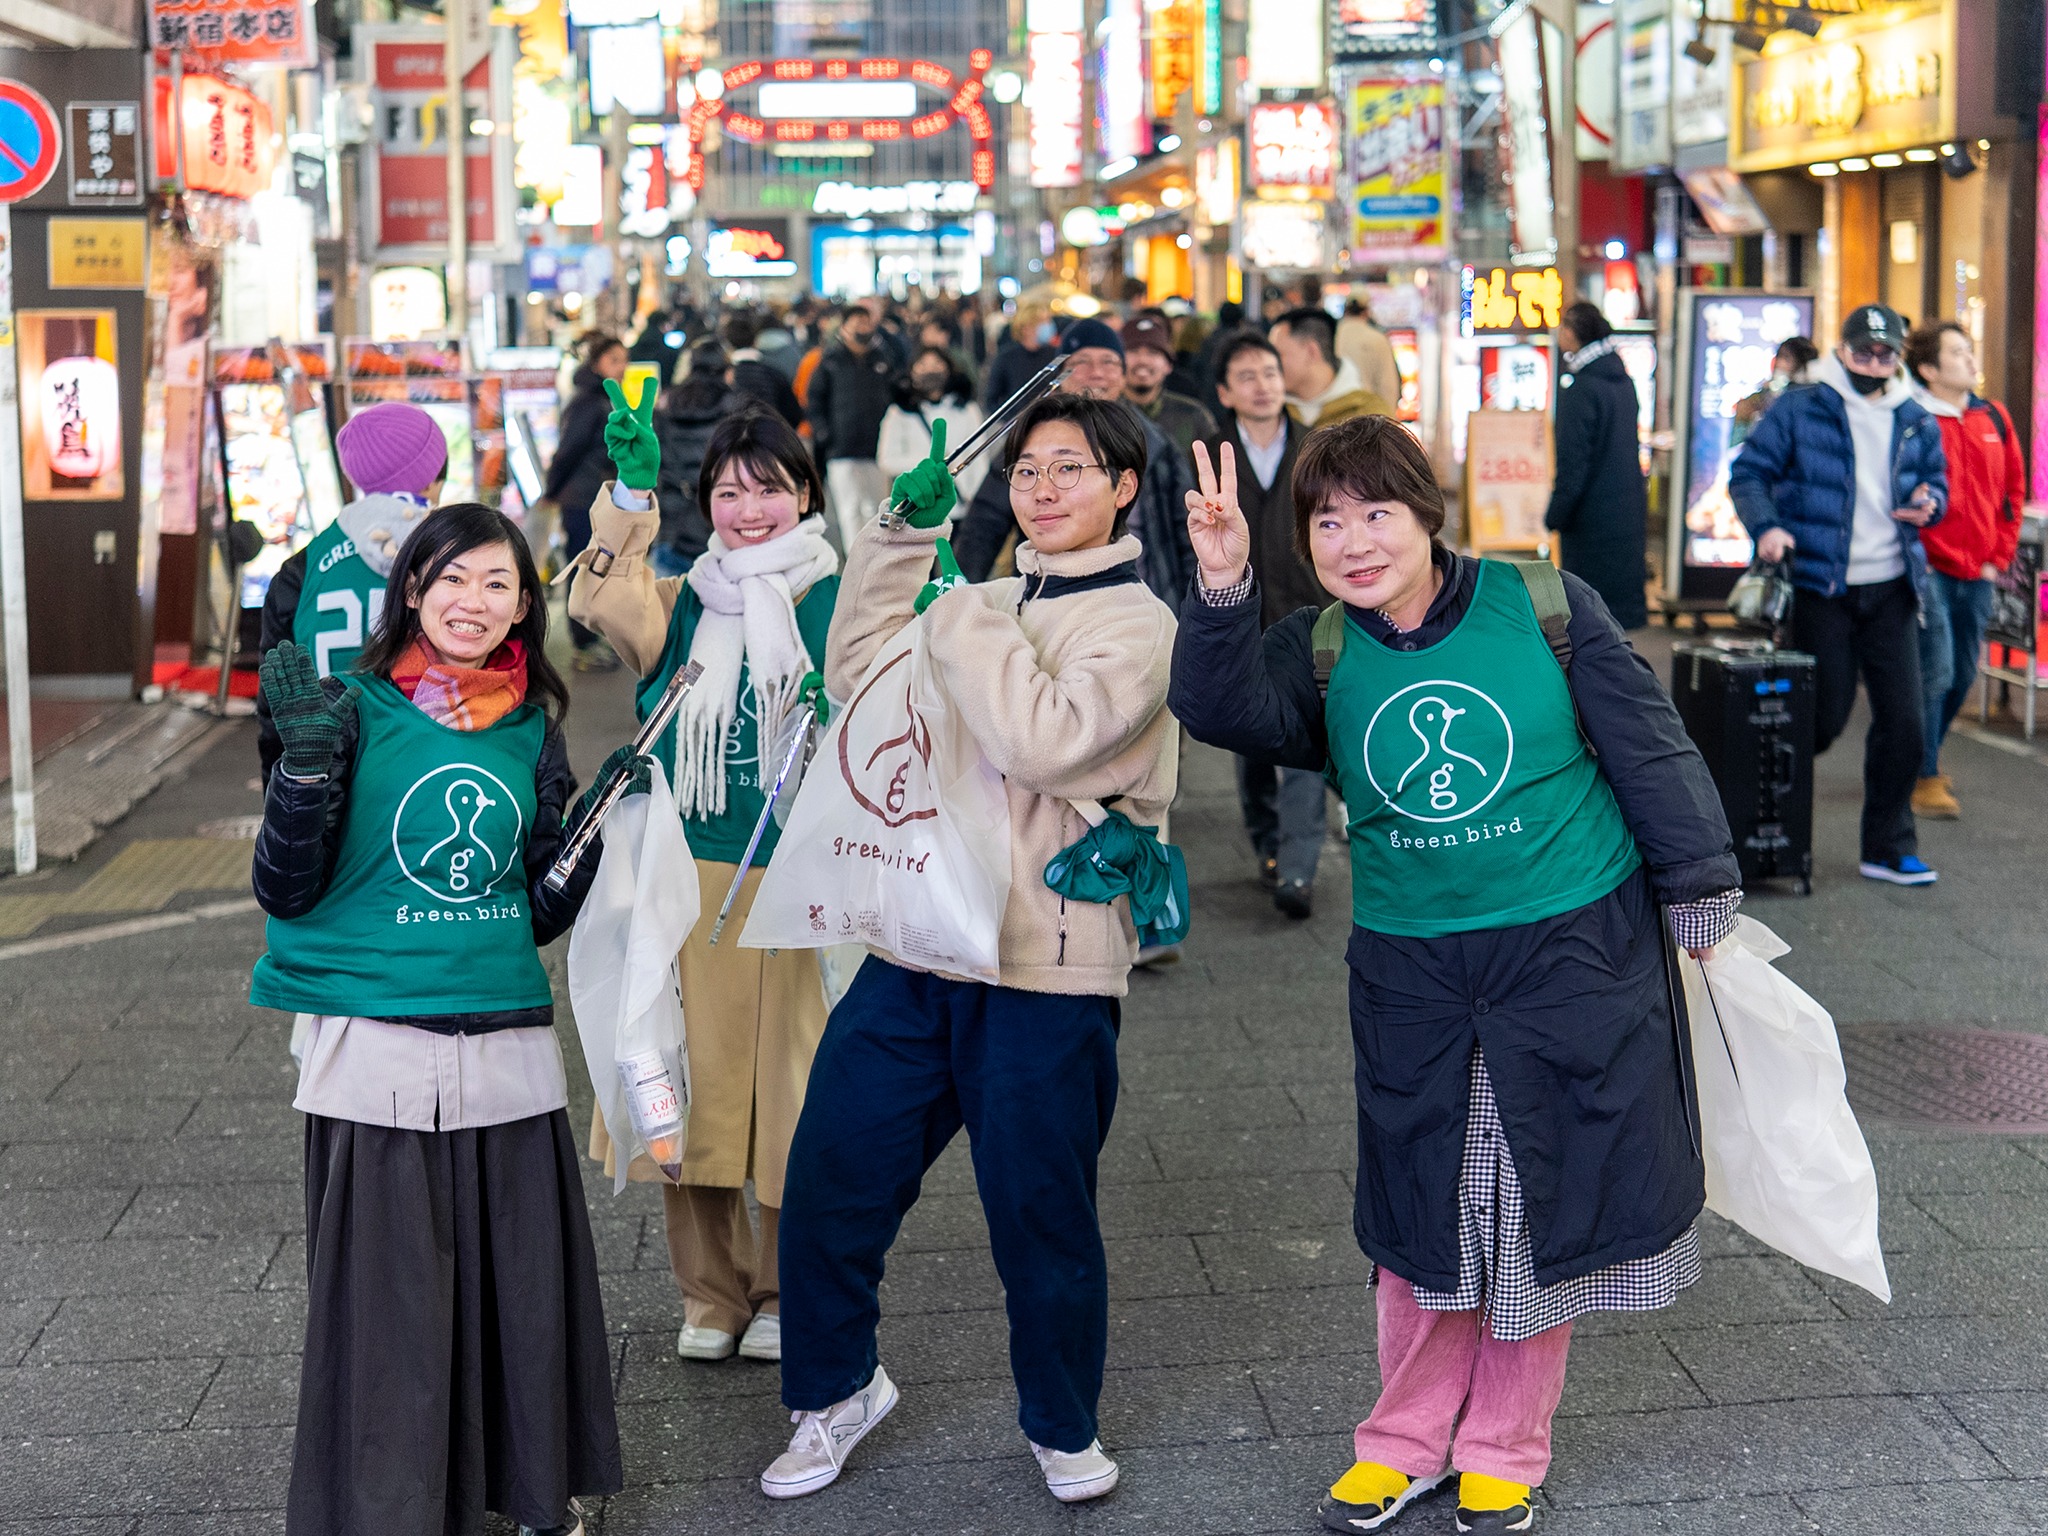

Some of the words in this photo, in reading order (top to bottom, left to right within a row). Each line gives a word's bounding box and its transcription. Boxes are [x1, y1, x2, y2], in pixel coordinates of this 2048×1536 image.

[319, 539, 359, 573] GRE
[1429, 763, 1458, 811] g
[1389, 829, 1459, 849] green
[1465, 817, 1523, 843] bird
[449, 848, 475, 891] g
[396, 904, 471, 924] green
[475, 903, 521, 921] bird
